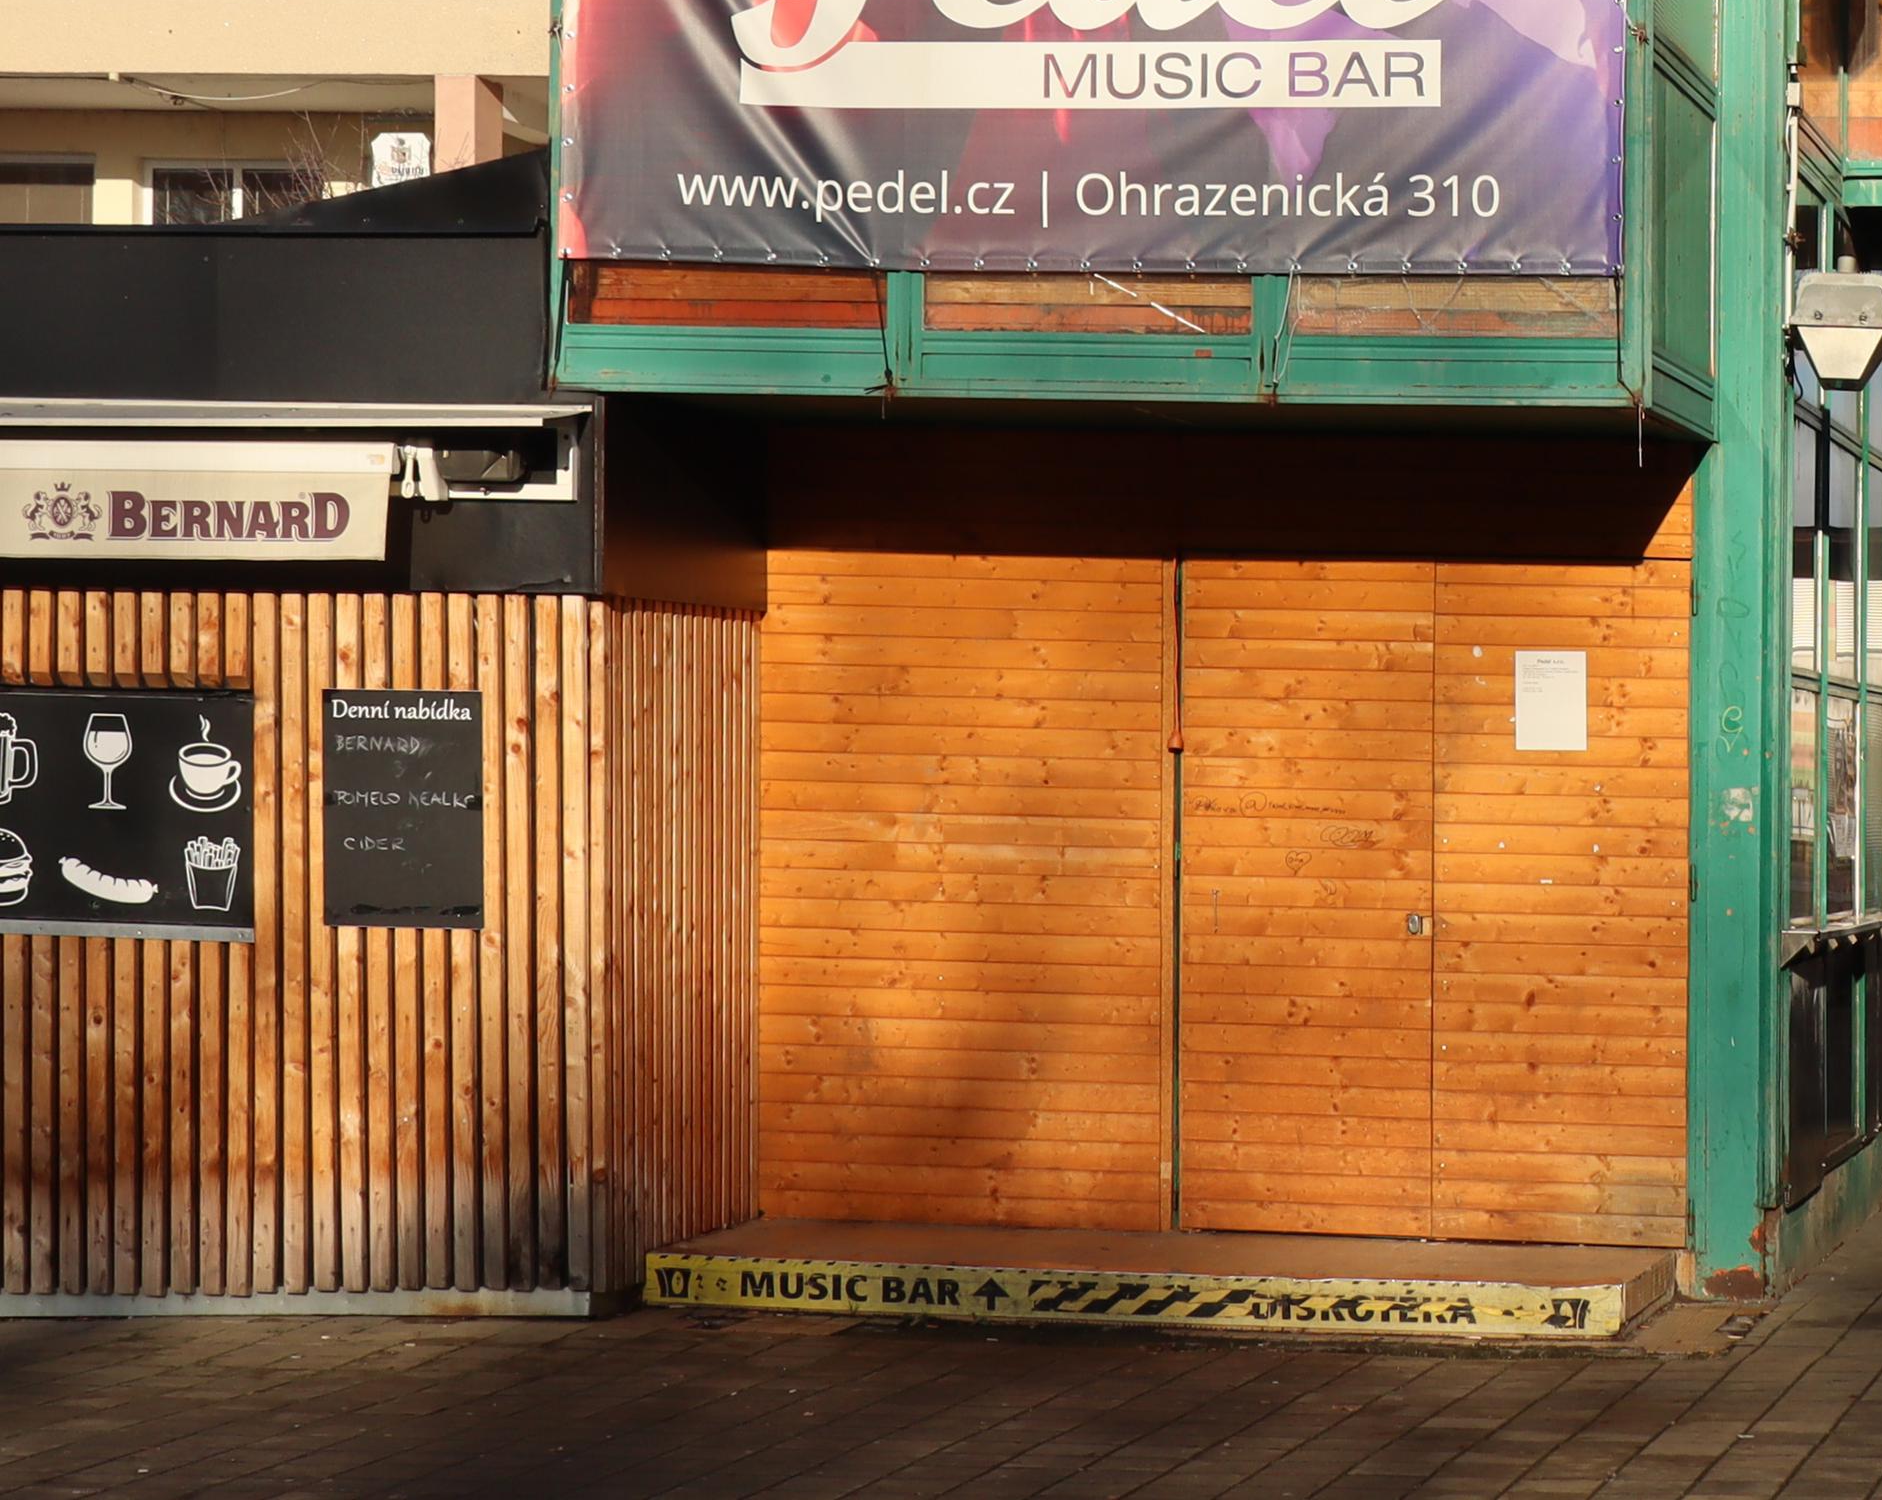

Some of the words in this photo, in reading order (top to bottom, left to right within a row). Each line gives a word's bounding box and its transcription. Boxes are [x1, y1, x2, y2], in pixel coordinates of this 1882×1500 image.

[1043, 51, 1262, 101] MUSIC
[1286, 50, 1427, 99] BAR
[677, 170, 1015, 222] www.pedel.cz
[1075, 168, 1391, 220] Ohrazenická
[1408, 175, 1500, 219] 310
[106, 490, 351, 541] BERNARD
[331, 698, 390, 719] Denní
[394, 697, 472, 721] nabídka
[334, 734, 420, 755] BERNARD
[334, 790, 401, 808] POMELO
[343, 836, 405, 851] CIDER
[740, 1269, 869, 1301] MUSIC
[881, 1275, 961, 1306] BAR
